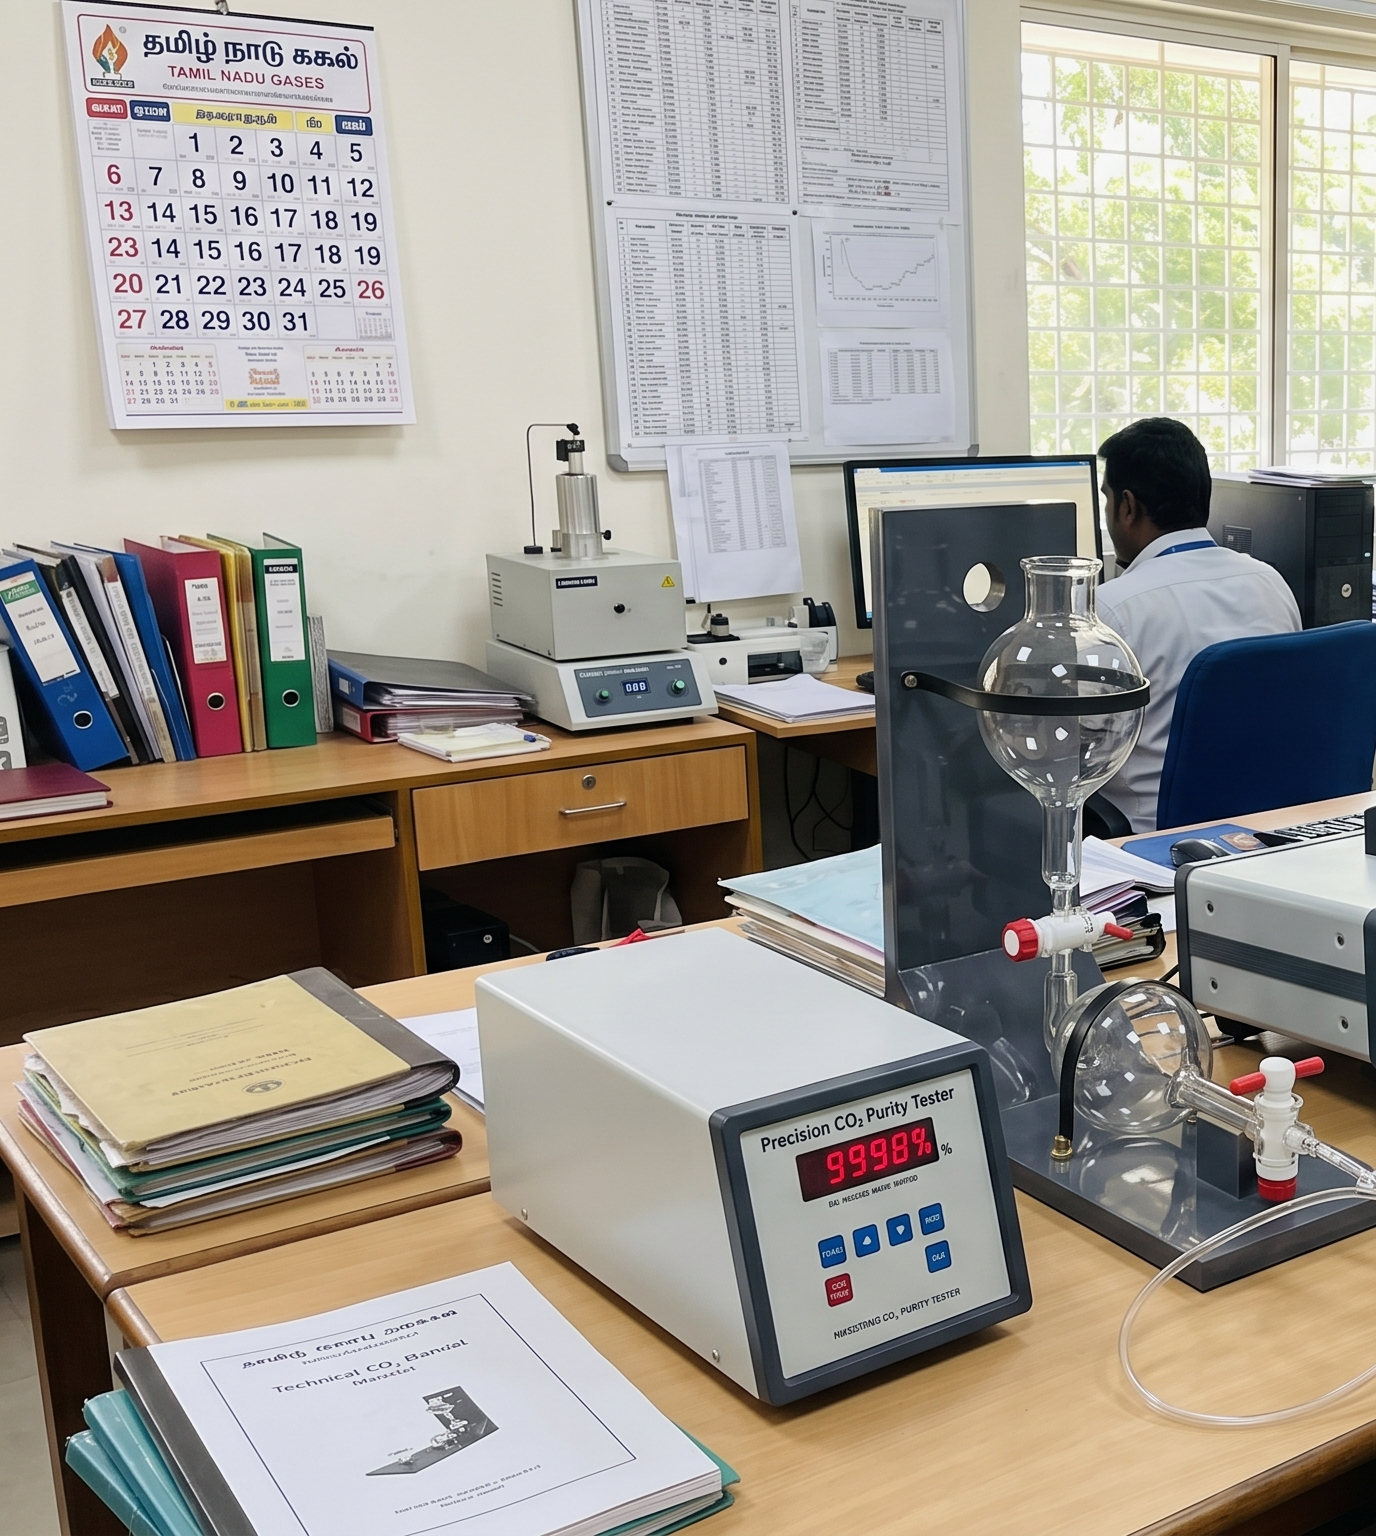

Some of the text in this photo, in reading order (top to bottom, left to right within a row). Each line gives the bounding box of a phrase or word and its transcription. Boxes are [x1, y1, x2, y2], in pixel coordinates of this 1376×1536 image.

[144, 30, 216, 63] தமிழ்
[224, 41, 283, 67] நாடு
[168, 66, 324, 89] TAMIL NADU GASES
[188, 132, 362, 162] 1 2 3 4 5
[108, 165, 374, 197] 6 7 8 9 10 11 12
[105, 200, 377, 231] 13 14 15 16 17 18 19
[109, 237, 380, 265] 23 14 15 16 17 18 19
[113, 273, 384, 299] 20 21 22 23 24 25 26
[118, 310, 307, 331] 27 28 29 30 31
[760, 1122, 831, 1153] Precision
[866, 1101, 908, 1123] Purity
[911, 1088, 955, 1109] Tester
[941, 1142, 953, 1156] %
[900, 1299, 929, 1316] PURITY
[931, 1287, 961, 1305] TESTER
[272, 1369, 360, 1394] Technical
